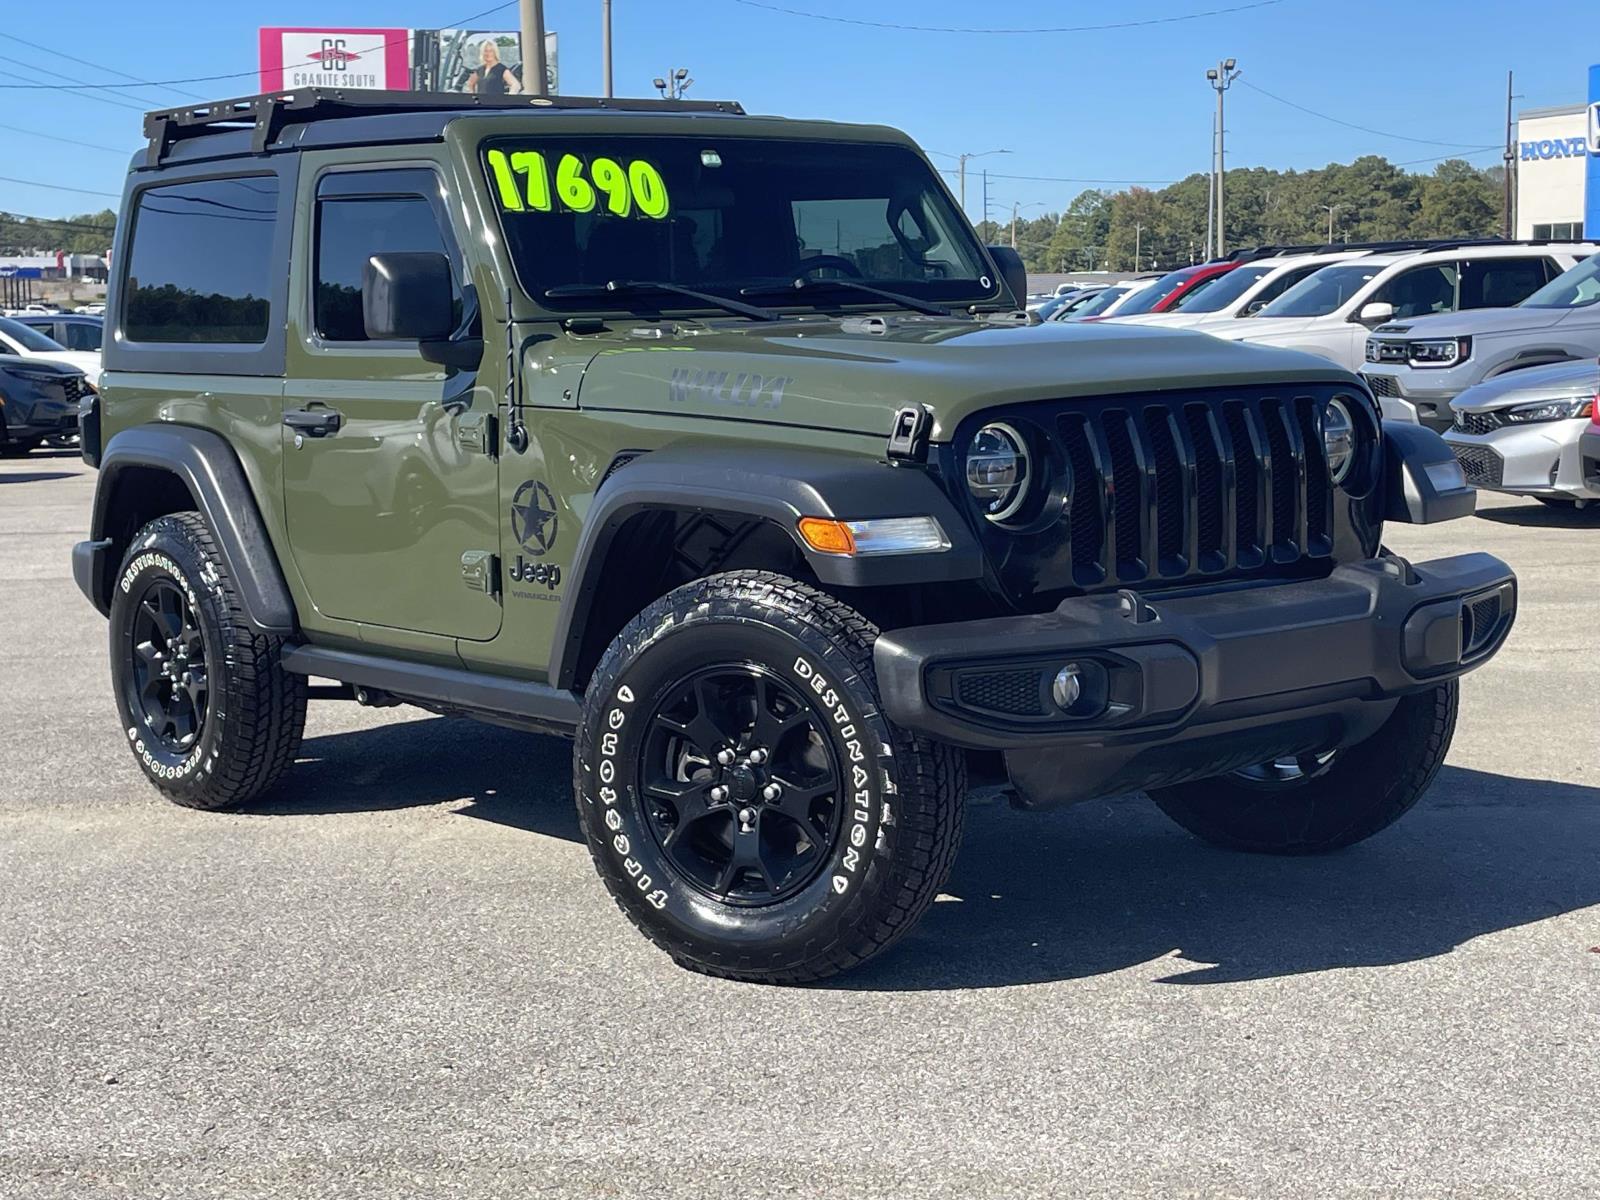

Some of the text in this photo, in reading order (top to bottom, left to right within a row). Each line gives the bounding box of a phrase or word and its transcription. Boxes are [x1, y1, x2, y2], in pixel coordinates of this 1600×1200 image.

[294, 73, 376, 88] GRANITE SOUTH
[1520, 137, 1586, 161] HOND
[488, 149, 669, 219] 17690
[509, 555, 561, 590] Jeep
[793, 657, 870, 872] DESTINATION
